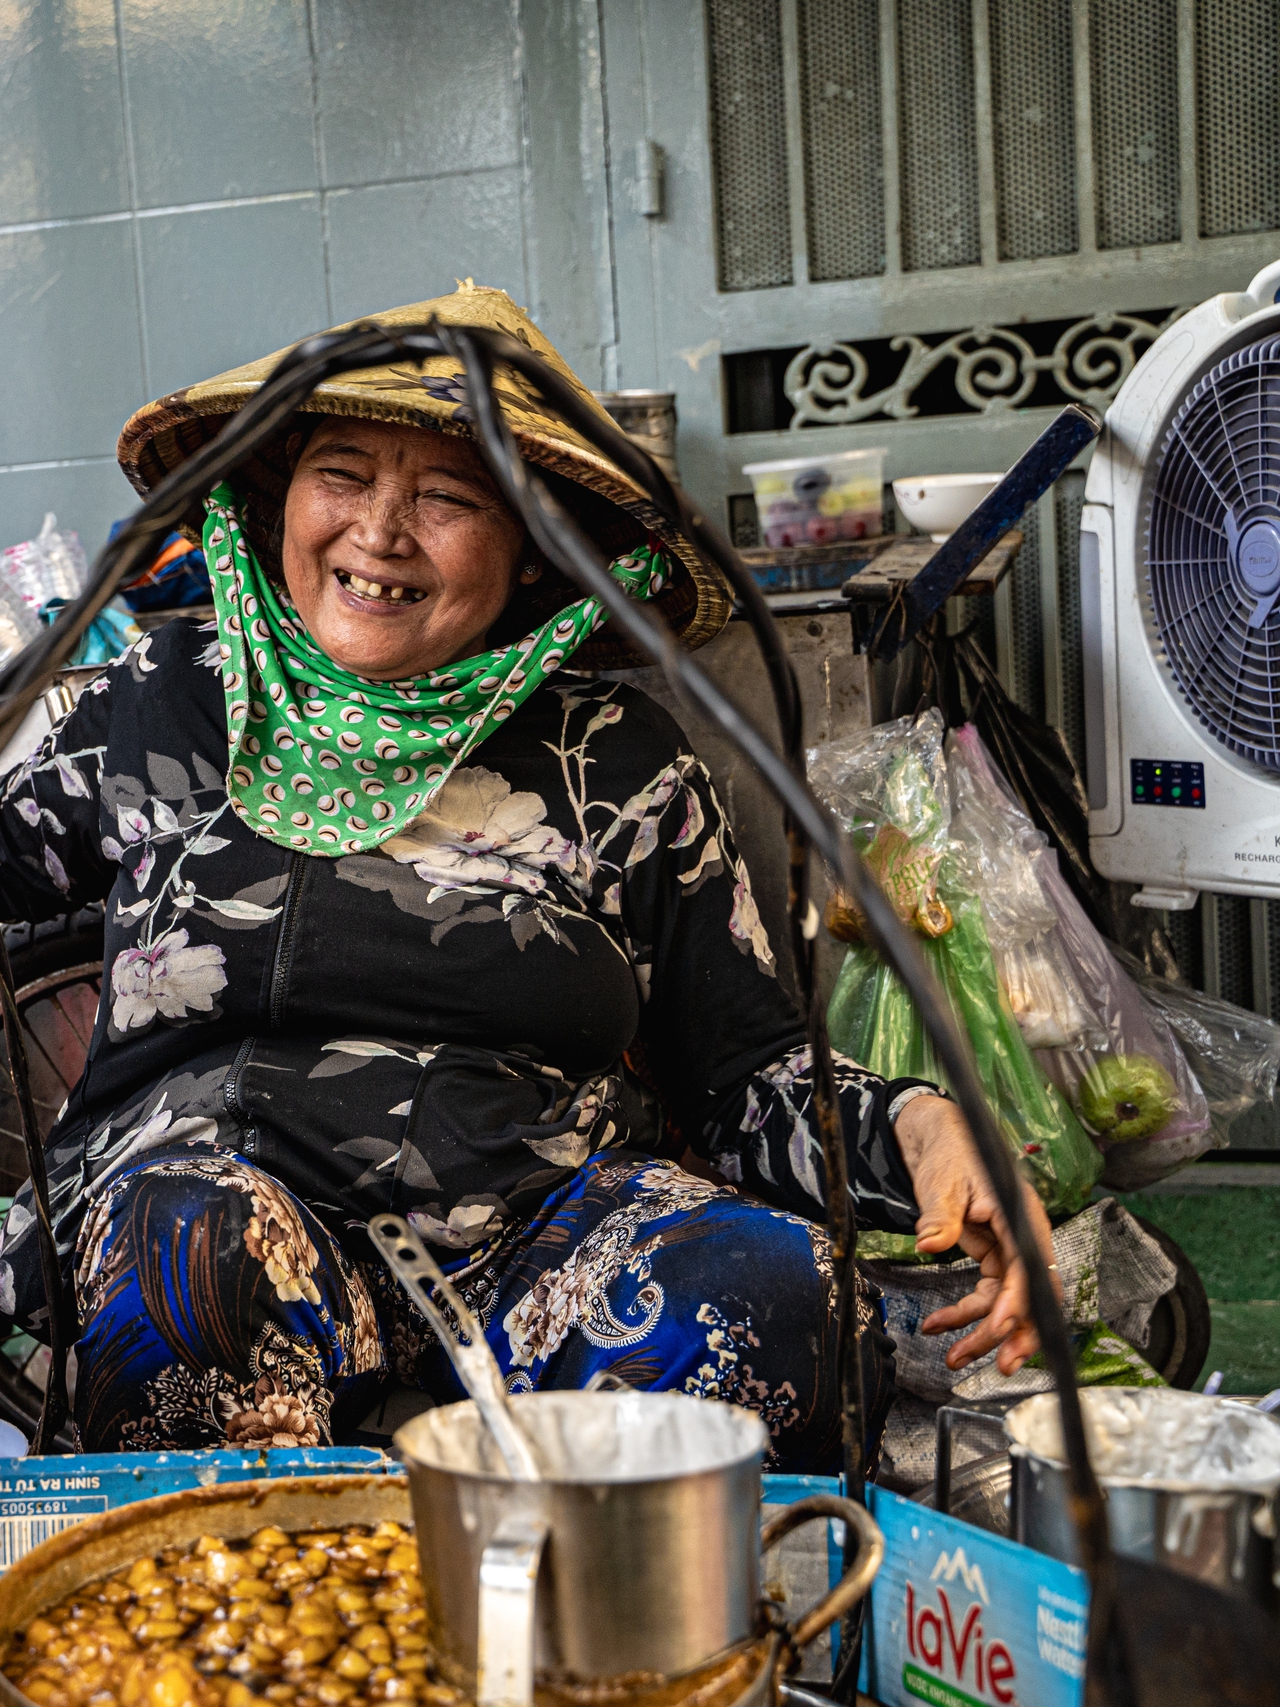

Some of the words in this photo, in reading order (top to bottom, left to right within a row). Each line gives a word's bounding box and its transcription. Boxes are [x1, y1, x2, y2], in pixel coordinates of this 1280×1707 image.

[15, 1479, 36, 1495] TỪ
[40, 1478, 61, 1490] RA
[64, 1476, 100, 1489] SINH
[906, 1579, 1015, 1704] laVie
